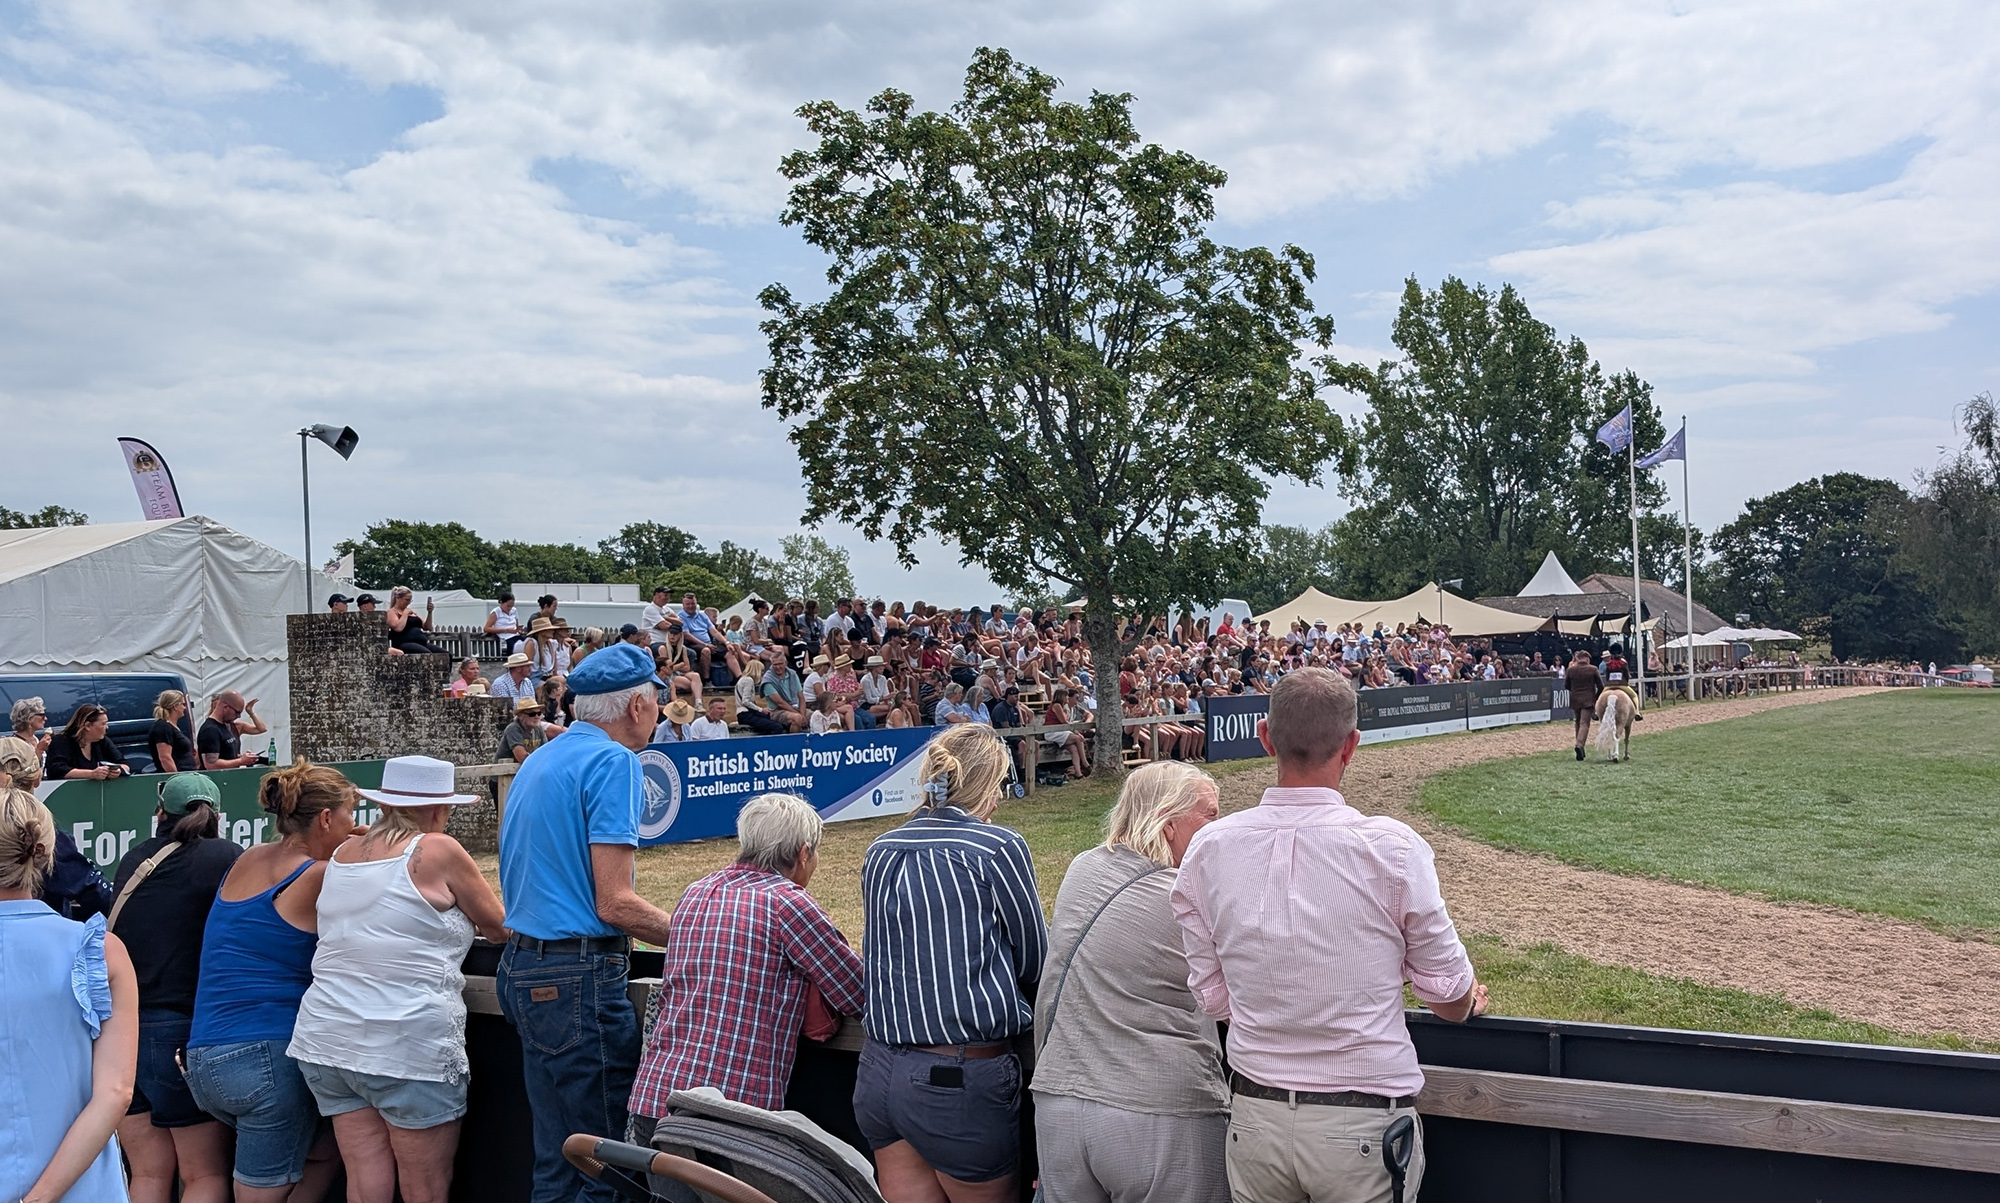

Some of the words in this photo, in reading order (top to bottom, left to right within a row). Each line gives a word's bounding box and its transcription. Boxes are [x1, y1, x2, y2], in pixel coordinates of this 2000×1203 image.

[151, 472, 166, 501] TEAM
[1212, 712, 1269, 742] ROWE
[687, 752, 749, 779] British
[753, 750, 798, 773] Show
[801, 748, 842, 771] Pony
[845, 743, 898, 766] Society
[687, 780, 750, 798] Excellence
[753, 777, 765, 791] in
[768, 773, 813, 789] Showing
[73, 821, 137, 867] For
